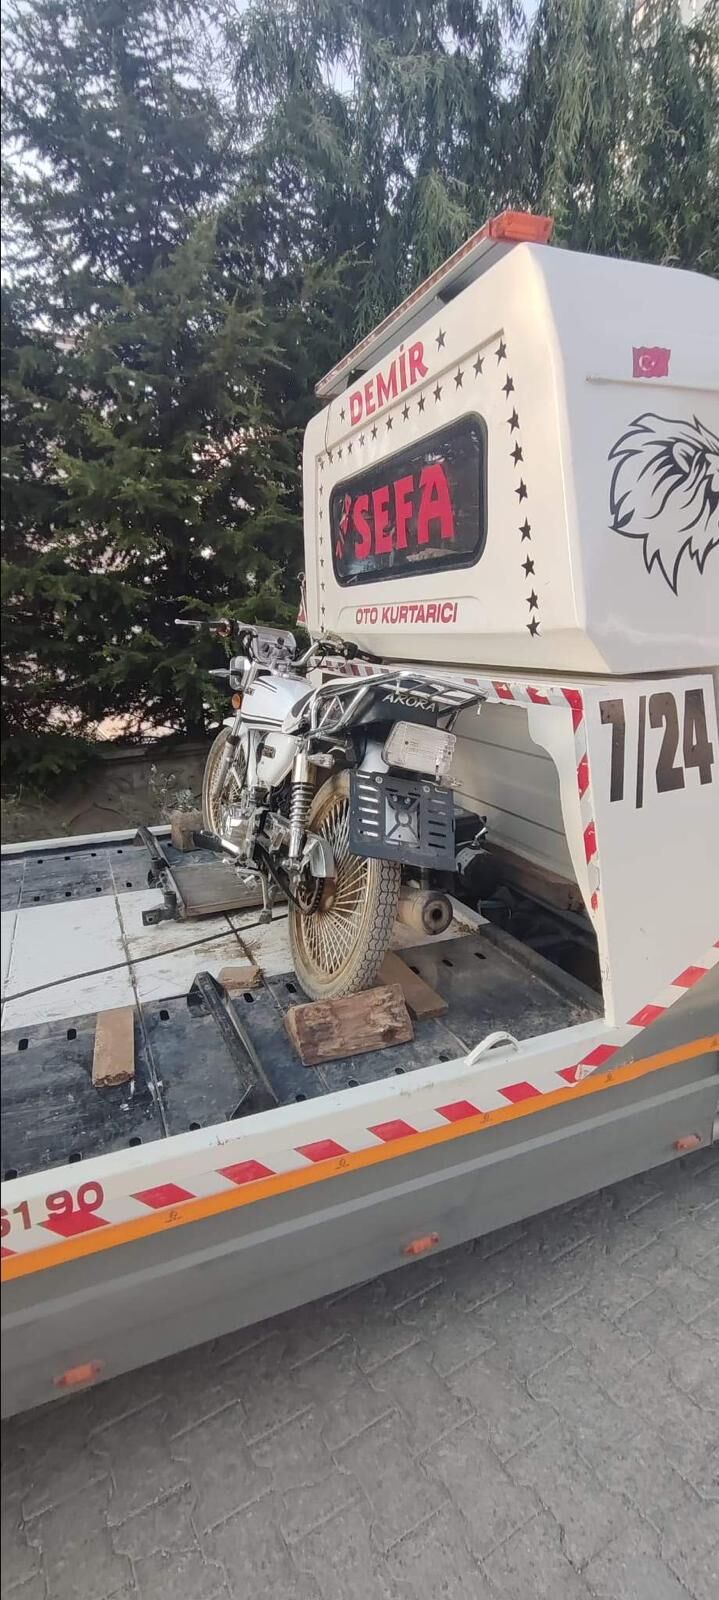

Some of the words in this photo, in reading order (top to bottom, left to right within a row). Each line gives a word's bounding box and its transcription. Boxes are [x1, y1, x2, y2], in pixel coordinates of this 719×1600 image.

[349, 341, 429, 426] DEMİR
[353, 463, 455, 560] SEFA
[355, 607, 378, 624] OTO
[381, 602, 458, 624] KURTARICI
[599, 688, 714, 809] 7/24
